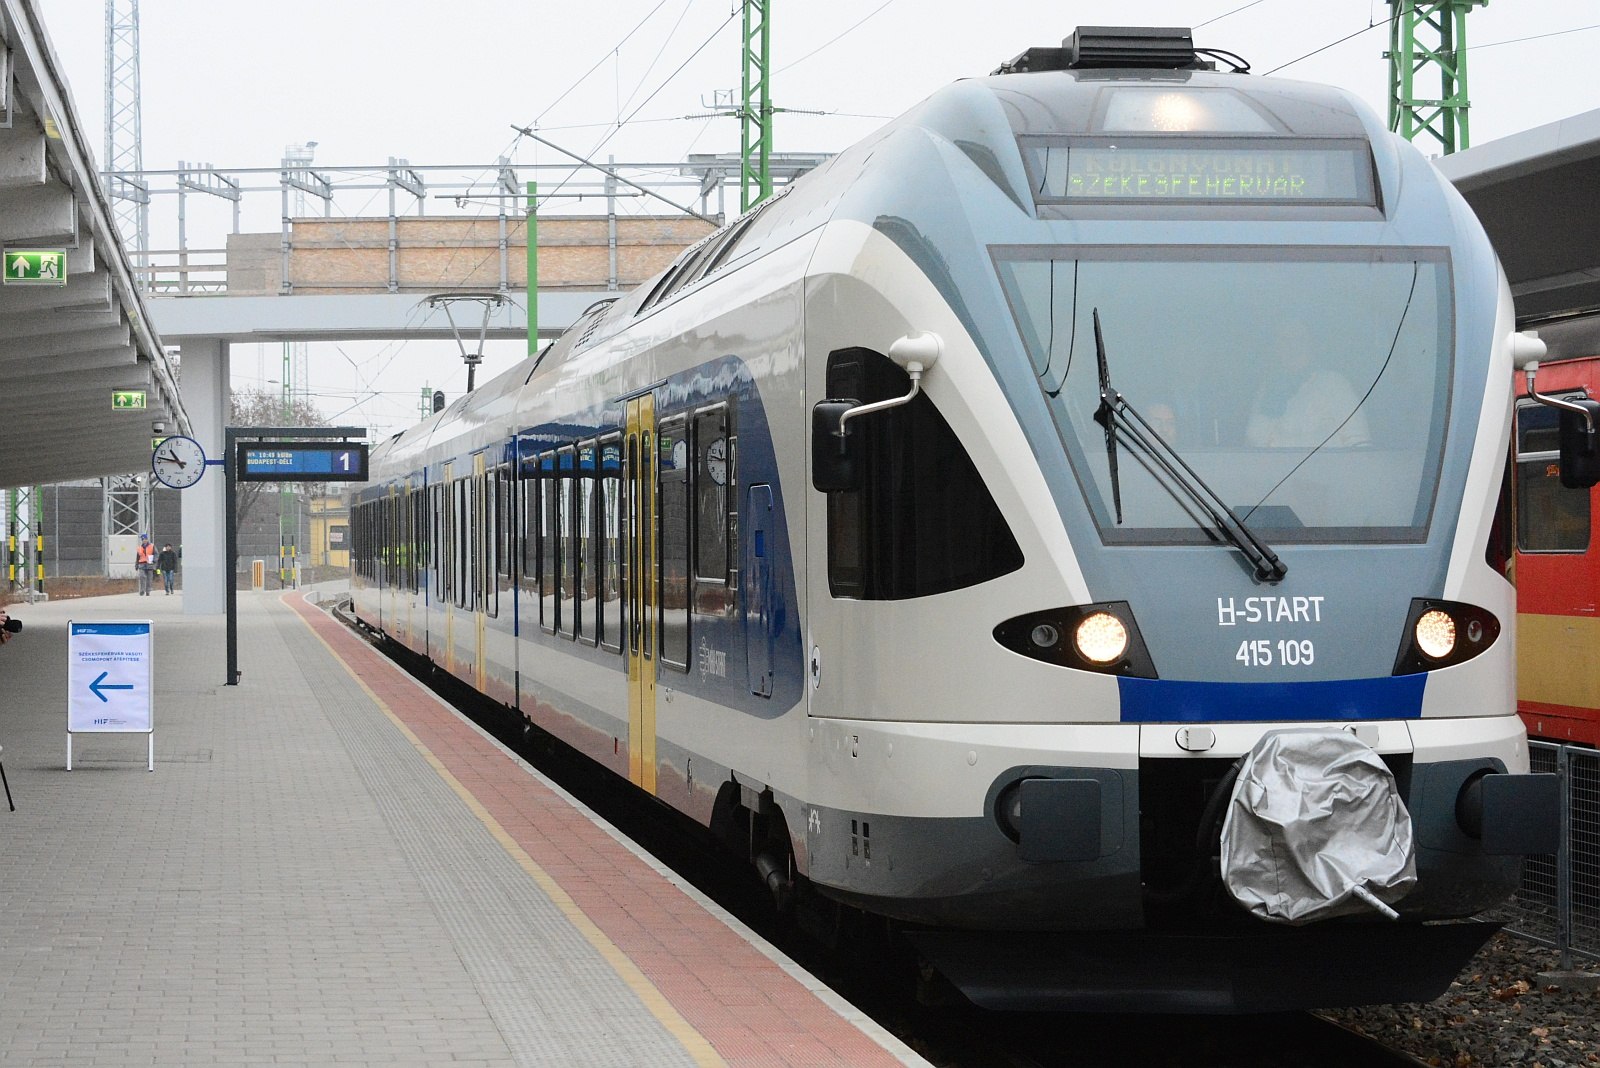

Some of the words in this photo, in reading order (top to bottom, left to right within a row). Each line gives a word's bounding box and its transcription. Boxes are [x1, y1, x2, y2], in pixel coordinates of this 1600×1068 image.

[340, 452, 349, 471] 1
[1218, 597, 1324, 623] H-START
[1236, 640, 1272, 666] 415
[1278, 640, 1314, 665] 109
